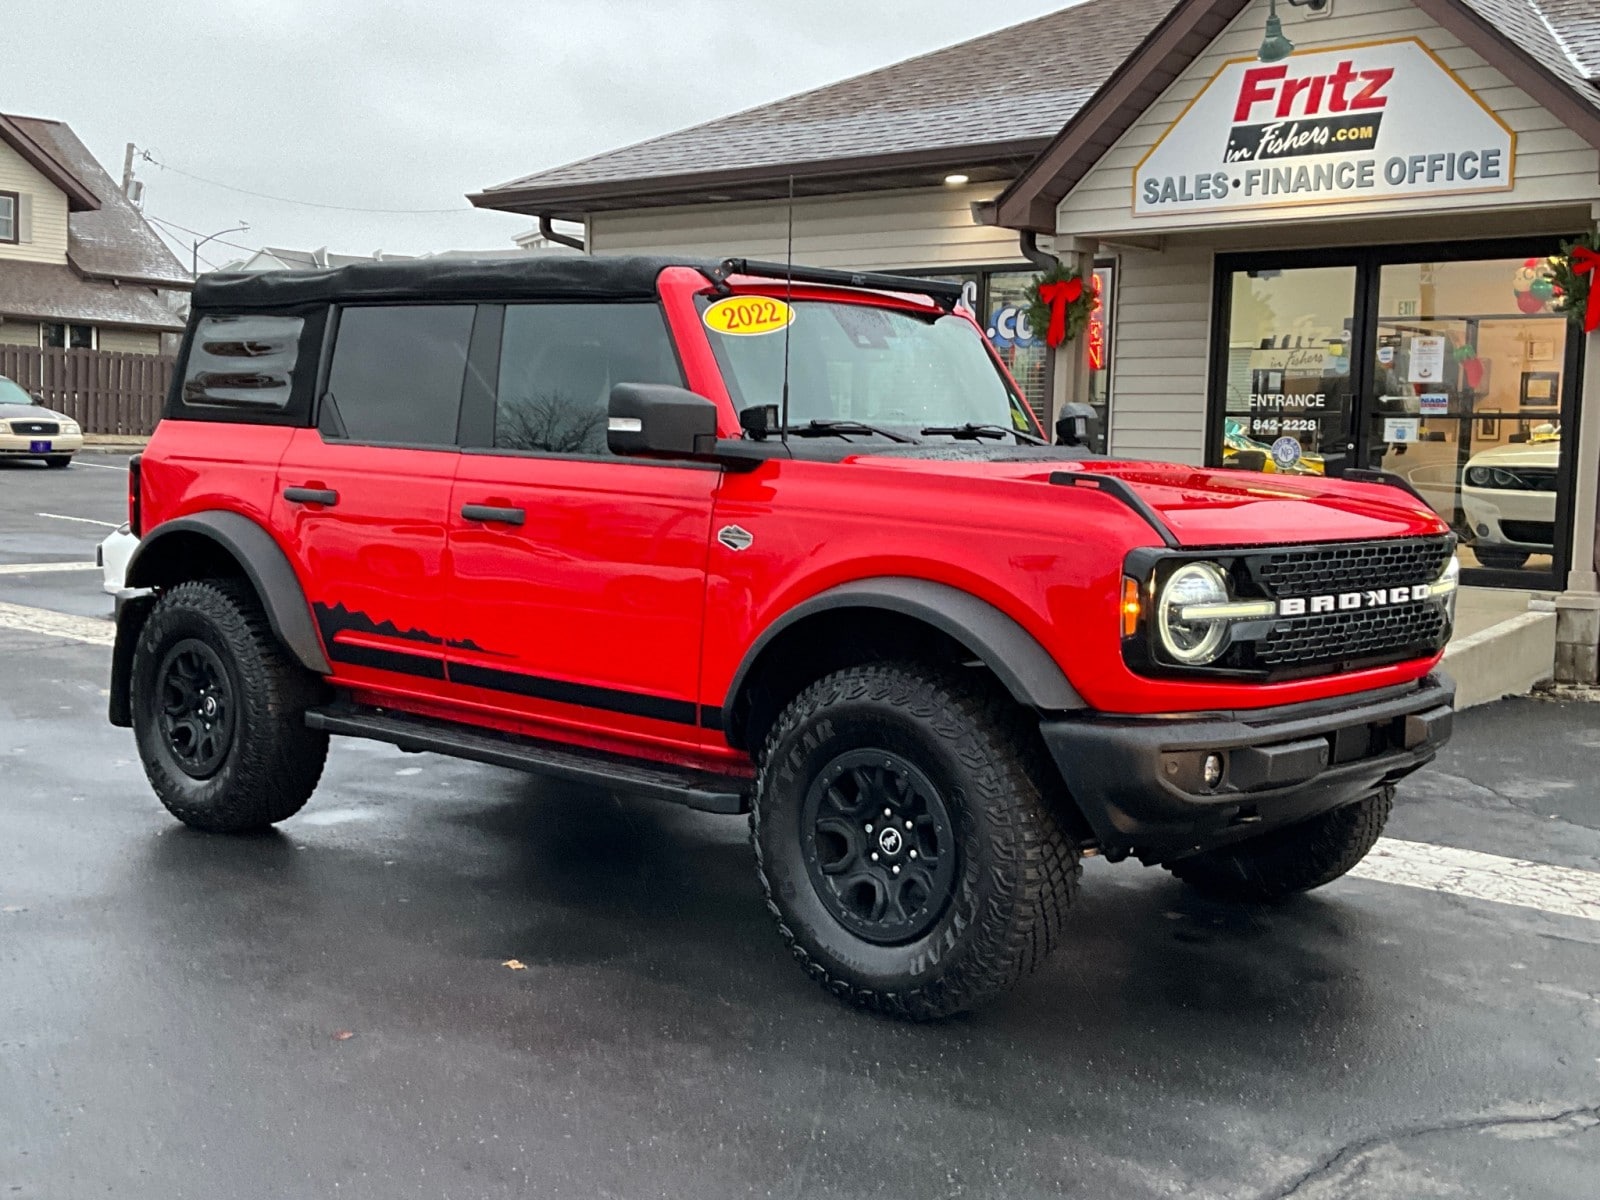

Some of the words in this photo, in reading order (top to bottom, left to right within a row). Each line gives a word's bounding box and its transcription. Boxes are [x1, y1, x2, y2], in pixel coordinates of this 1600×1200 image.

[1233, 60, 1395, 122] Fritz
[1226, 140, 1251, 163] in
[1254, 122, 1329, 161] Fishers
[1143, 171, 1229, 204] SALES
[1244, 159, 1376, 197] FINANCE
[1384, 149, 1501, 185] OFFICE
[722, 302, 781, 329] 2022
[1398, 301, 1417, 315] EXIT
[1248, 394, 1326, 407] ENTRANCE
[1252, 419, 1317, 431] 842-2228
[1279, 584, 1430, 616] BRONCO
